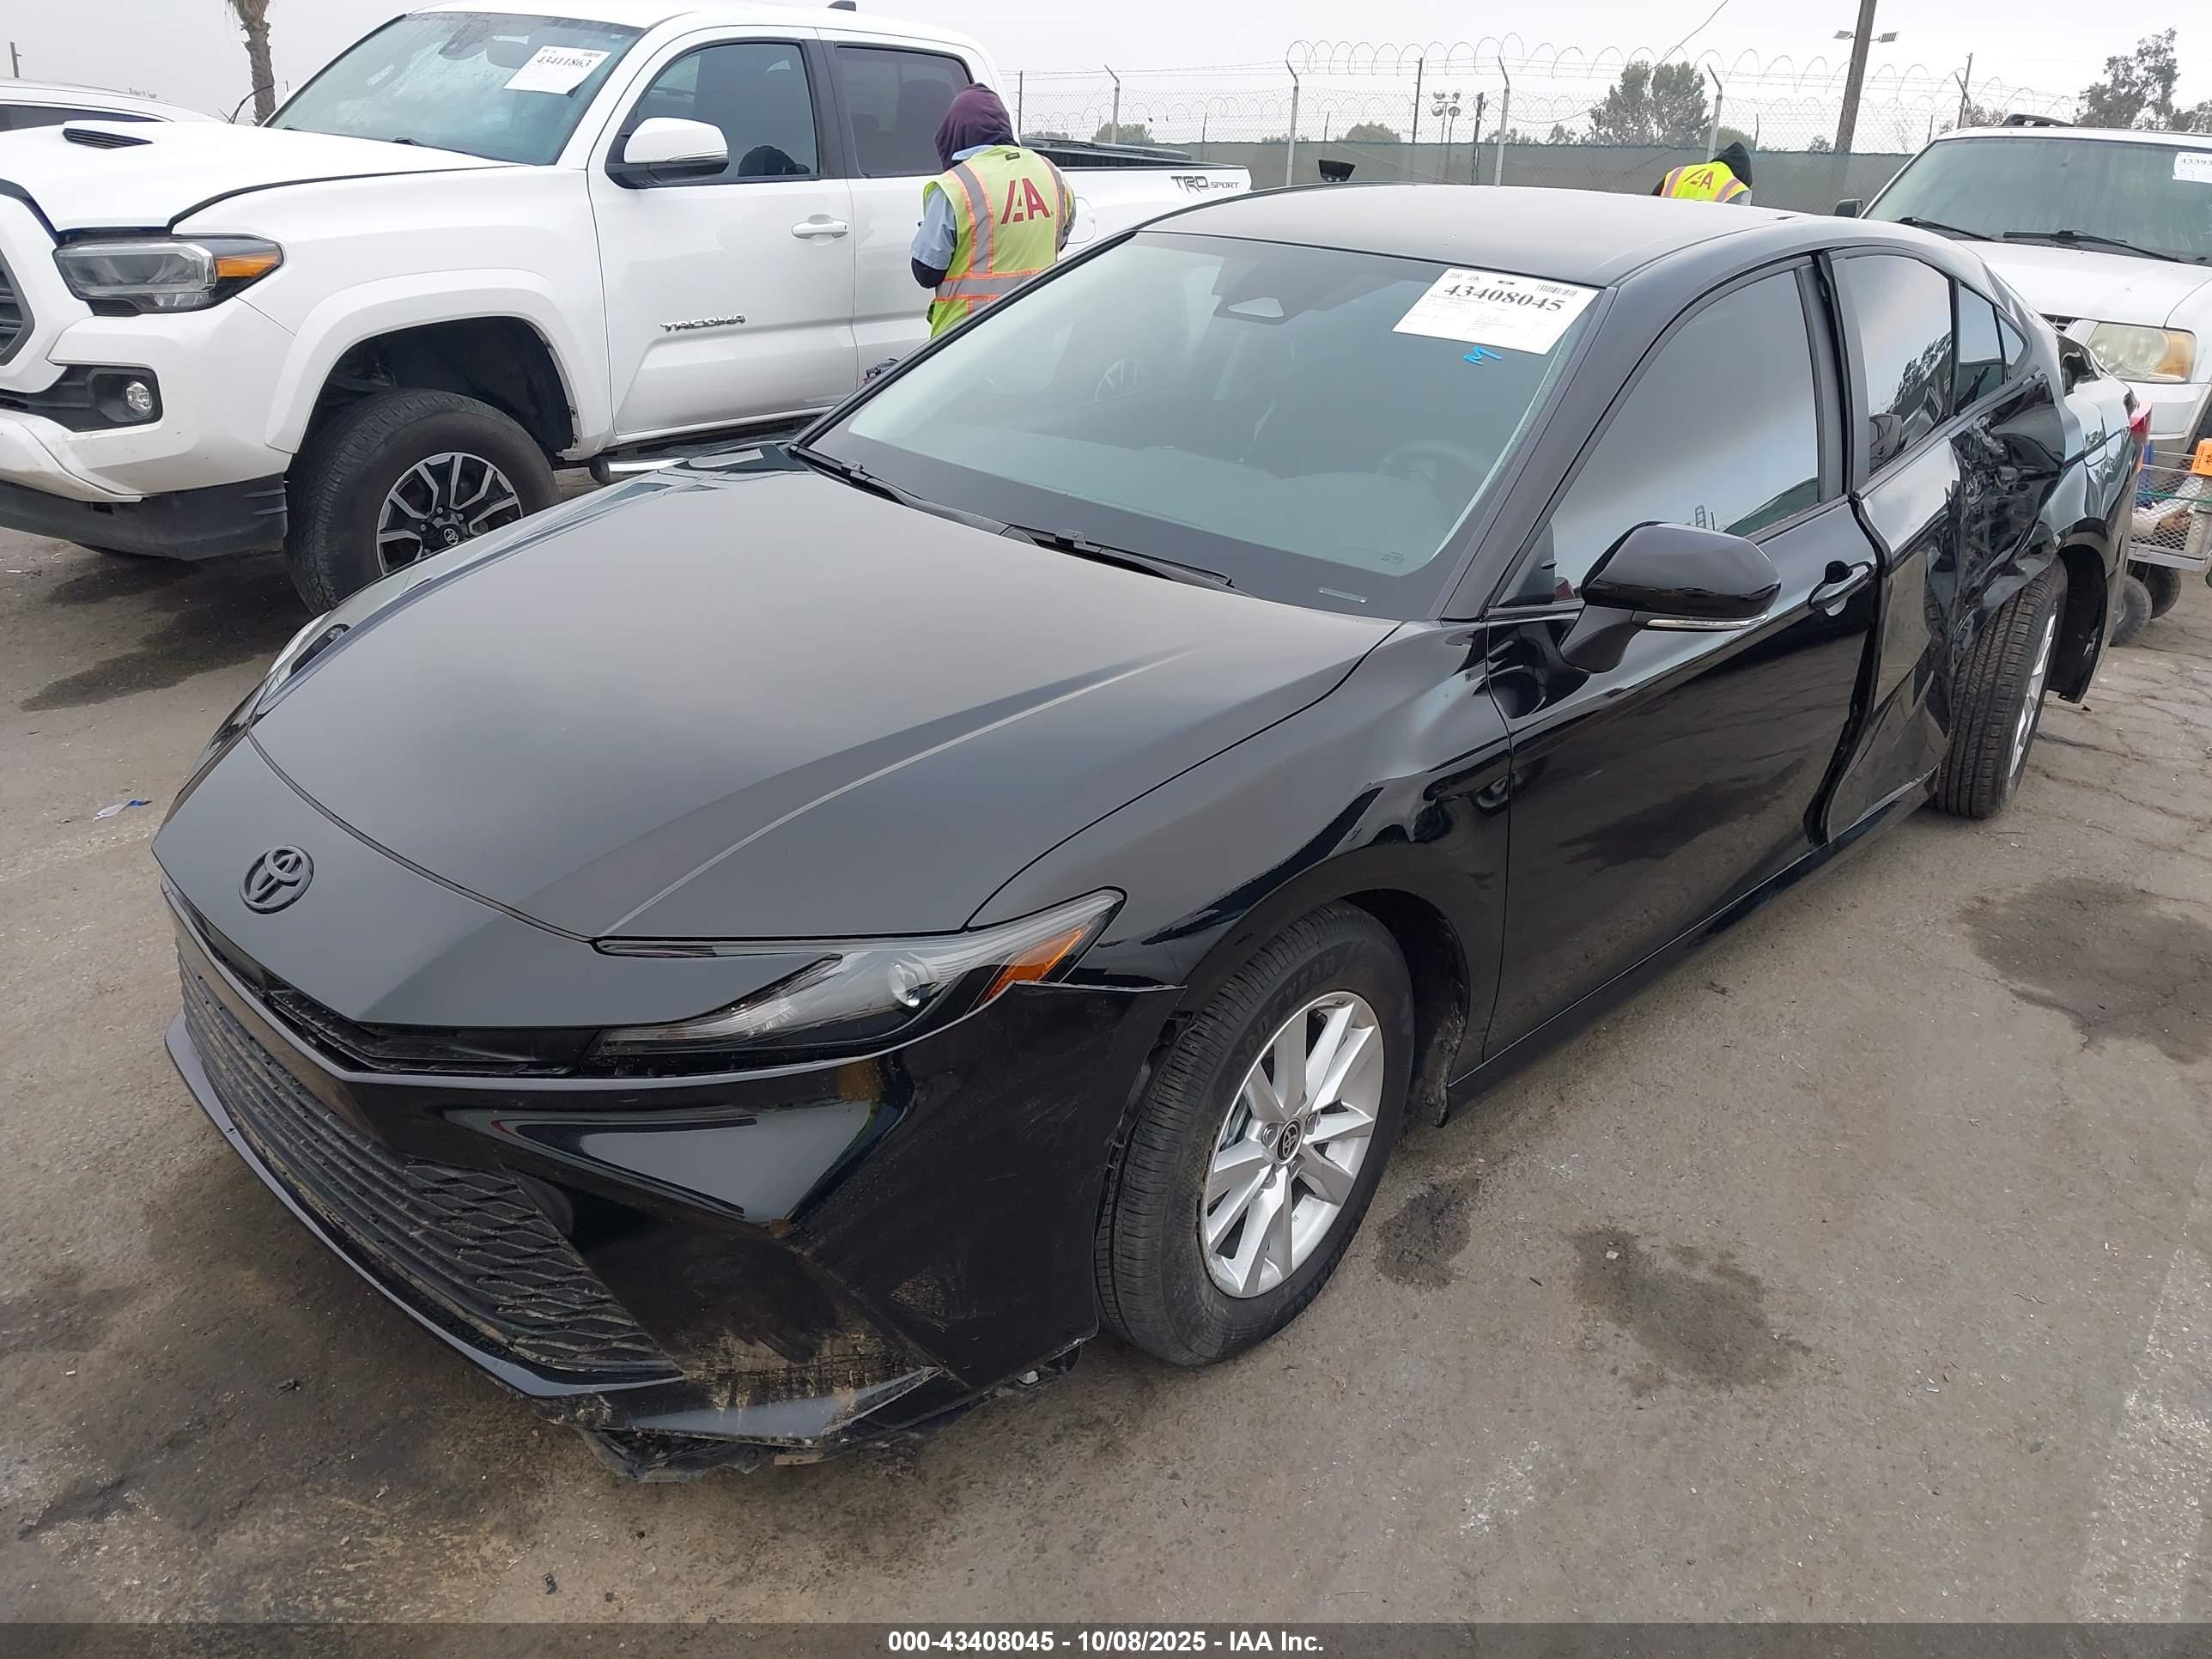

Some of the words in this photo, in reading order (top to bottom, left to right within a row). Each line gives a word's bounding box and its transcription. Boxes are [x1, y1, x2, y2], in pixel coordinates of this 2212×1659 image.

[537, 56, 592, 68] 43411863
[1170, 176, 1208, 193] TRD
[1444, 284, 1566, 312] 43408045
[660, 313, 746, 332] TACOMA
